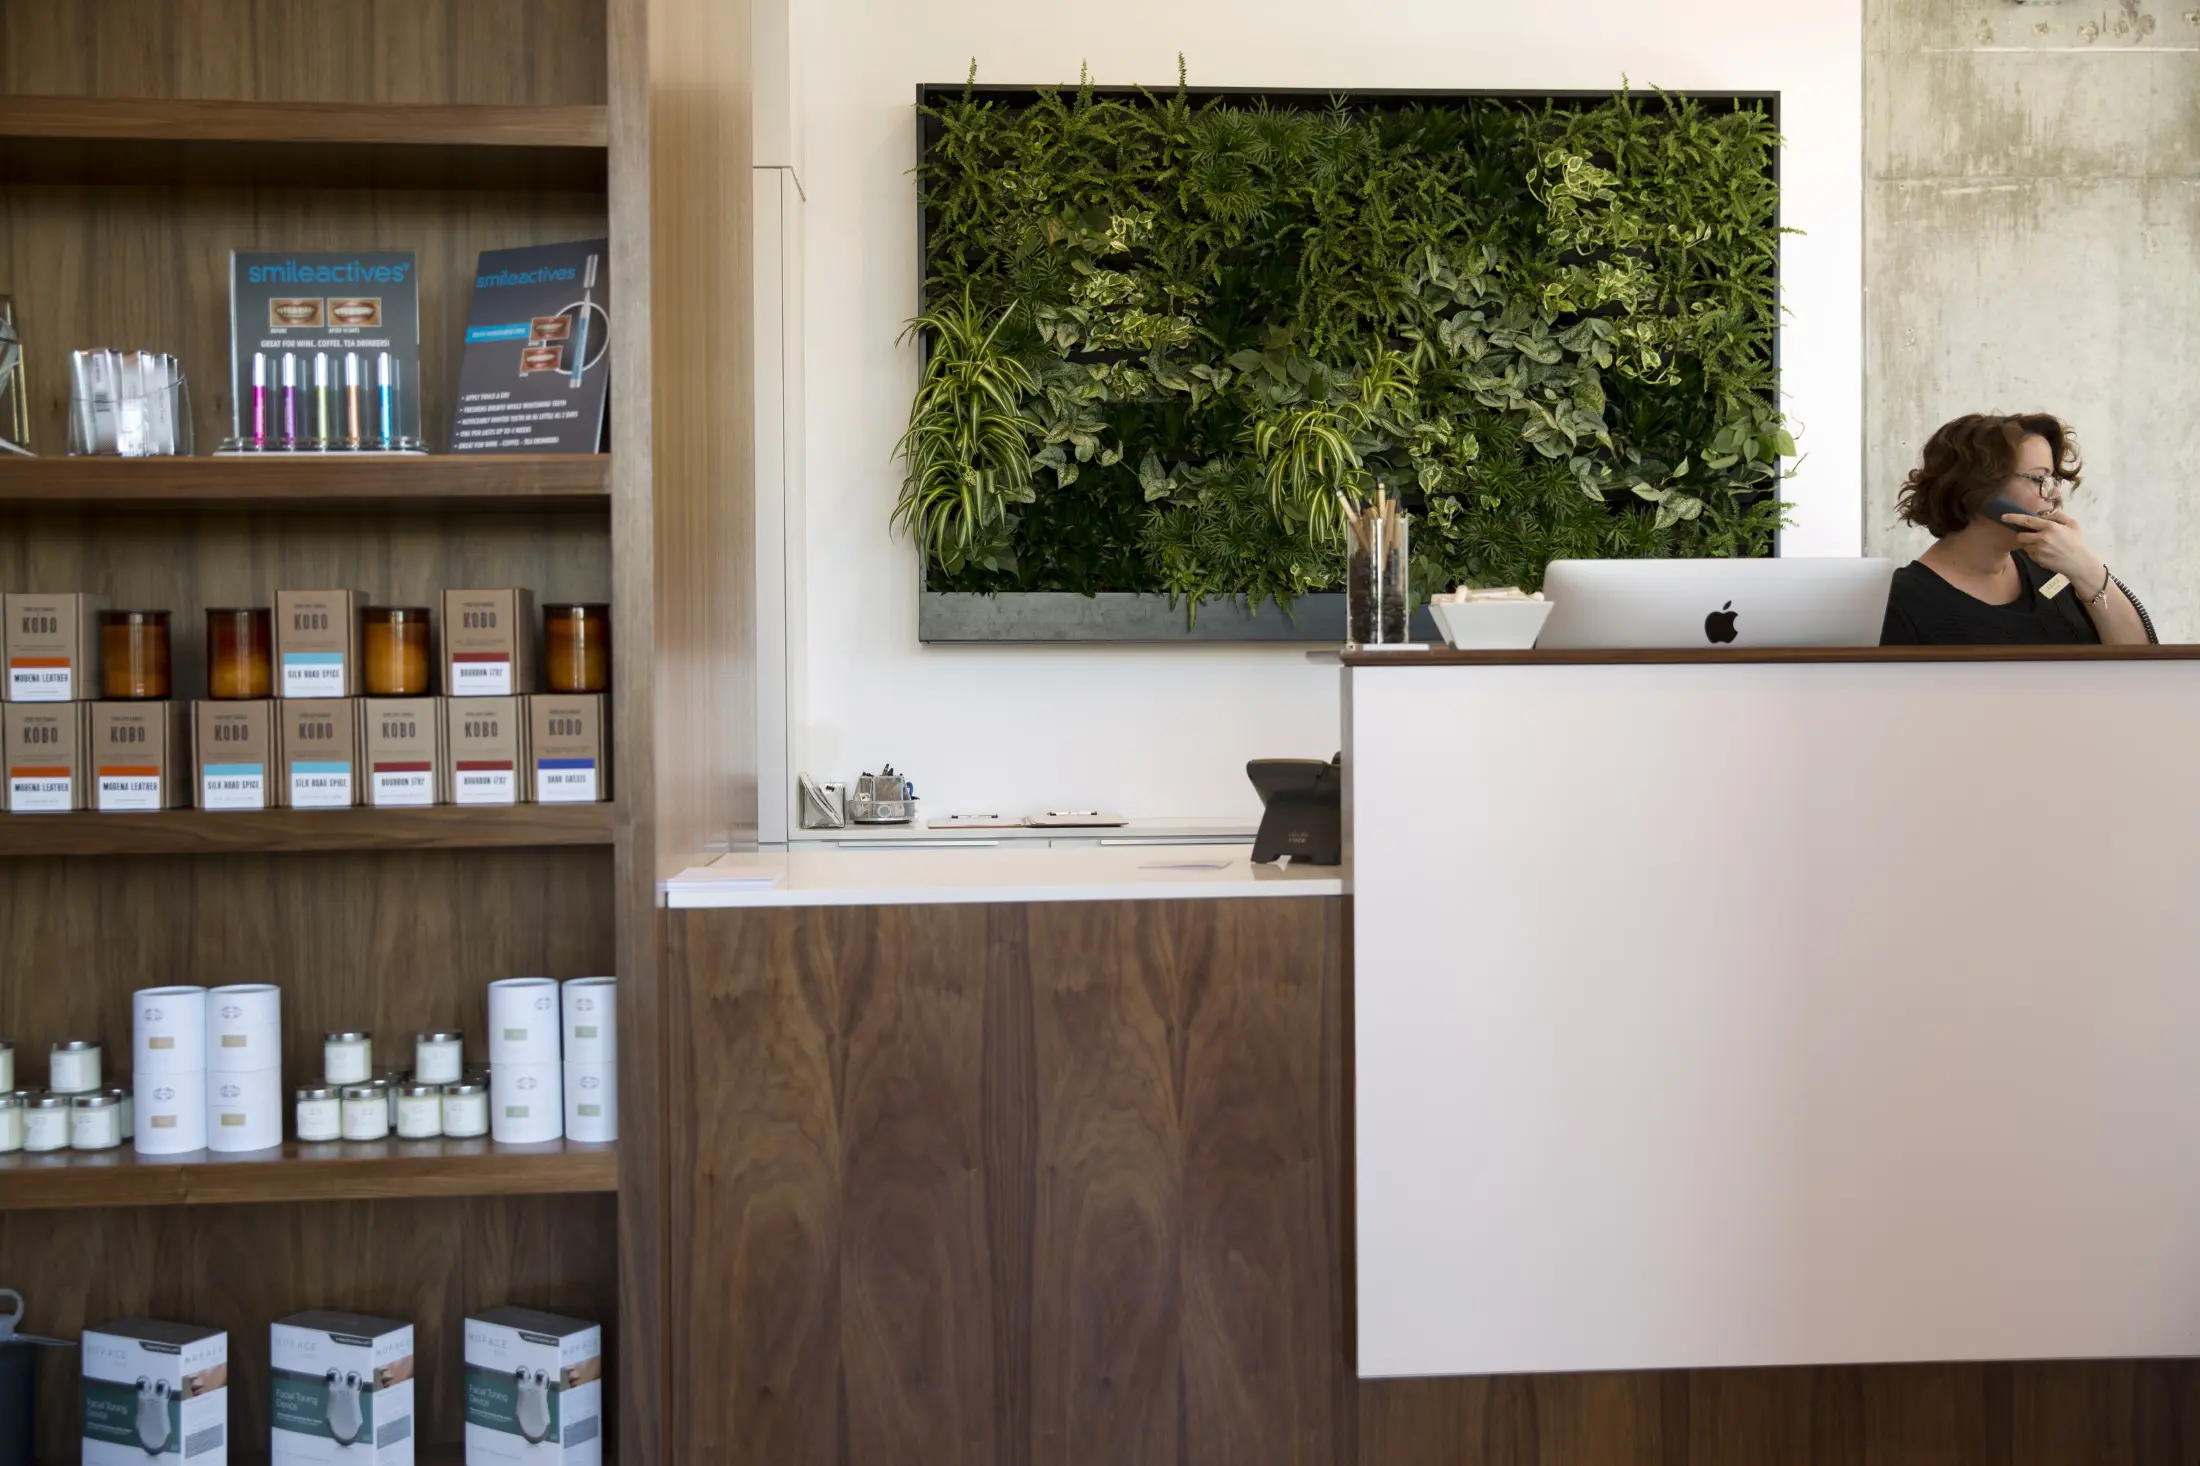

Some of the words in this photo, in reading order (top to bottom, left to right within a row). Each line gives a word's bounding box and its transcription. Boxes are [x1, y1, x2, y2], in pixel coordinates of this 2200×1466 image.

[248, 259, 409, 284] smileactives
[475, 266, 577, 289] smileactives
[282, 340, 296, 348] FOR
[22, 616, 58, 634] KOBO
[293, 613, 329, 631] KOBO
[462, 611, 498, 629] KOBO
[42, 673, 69, 682] LEATHER
[322, 669, 340, 679] SPICE
[23, 726, 59, 744] KOBO
[110, 726, 146, 743] KOBO
[214, 724, 249, 742] KOBO
[298, 722, 334, 740] KOBO
[381, 721, 416, 738] KOBO
[464, 721, 499, 738] KOBO
[548, 719, 582, 736] KOBO
[42, 782, 69, 792] LEATHER
[130, 781, 158, 791] LEATHER
[207, 780, 222, 790] SILK
[241, 780, 260, 789] SPICE
[329, 778, 348, 788] SPICE
